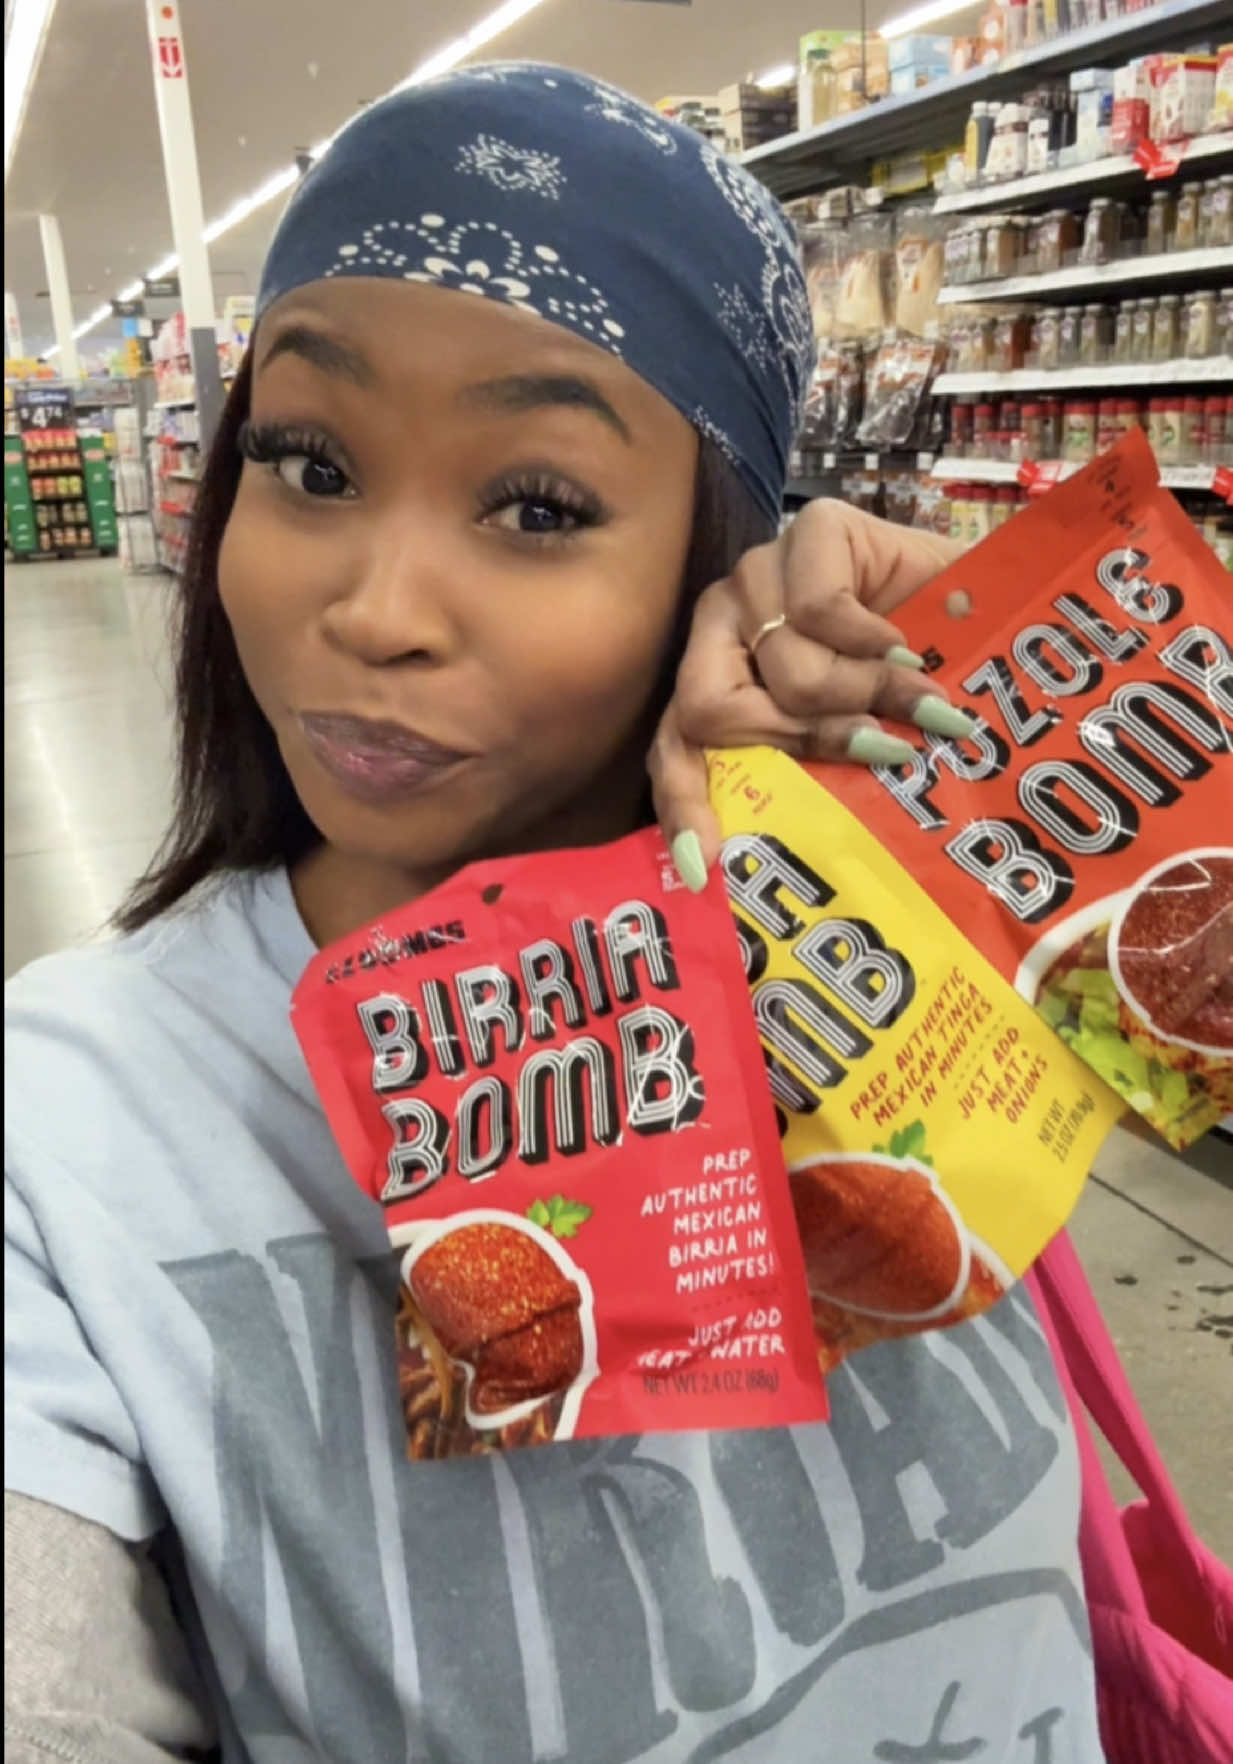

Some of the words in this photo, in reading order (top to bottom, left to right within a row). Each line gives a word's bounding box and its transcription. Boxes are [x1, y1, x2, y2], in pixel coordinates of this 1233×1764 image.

[357, 899, 680, 1094] BIRRIA
[850, 1072, 888, 1121] PREP
[896, 966, 965, 1071] AUTHENTIC
[873, 1046, 937, 1128] MEXICAN
[939, 983, 979, 1041] TINGA
[920, 1081, 937, 1108] IN
[939, 997, 992, 1080] MINUTES
[958, 1064, 990, 1120] JUST
[993, 1027, 1019, 1065] ADD
[1005, 1054, 1049, 1124] ONIONS
[379, 1004, 706, 1208] BOMB
[703, 1148, 751, 1175] PREP
[641, 1173, 758, 1217] AUTHENTIC
[673, 1202, 761, 1236] MEXICAN
[668, 1234, 738, 1268] BIRRIA
[747, 1228, 767, 1250] IN
[676, 1252, 775, 1294] MINUTES!
[687, 1315, 738, 1347] JUST
[710, 1334, 786, 1361] WATER
